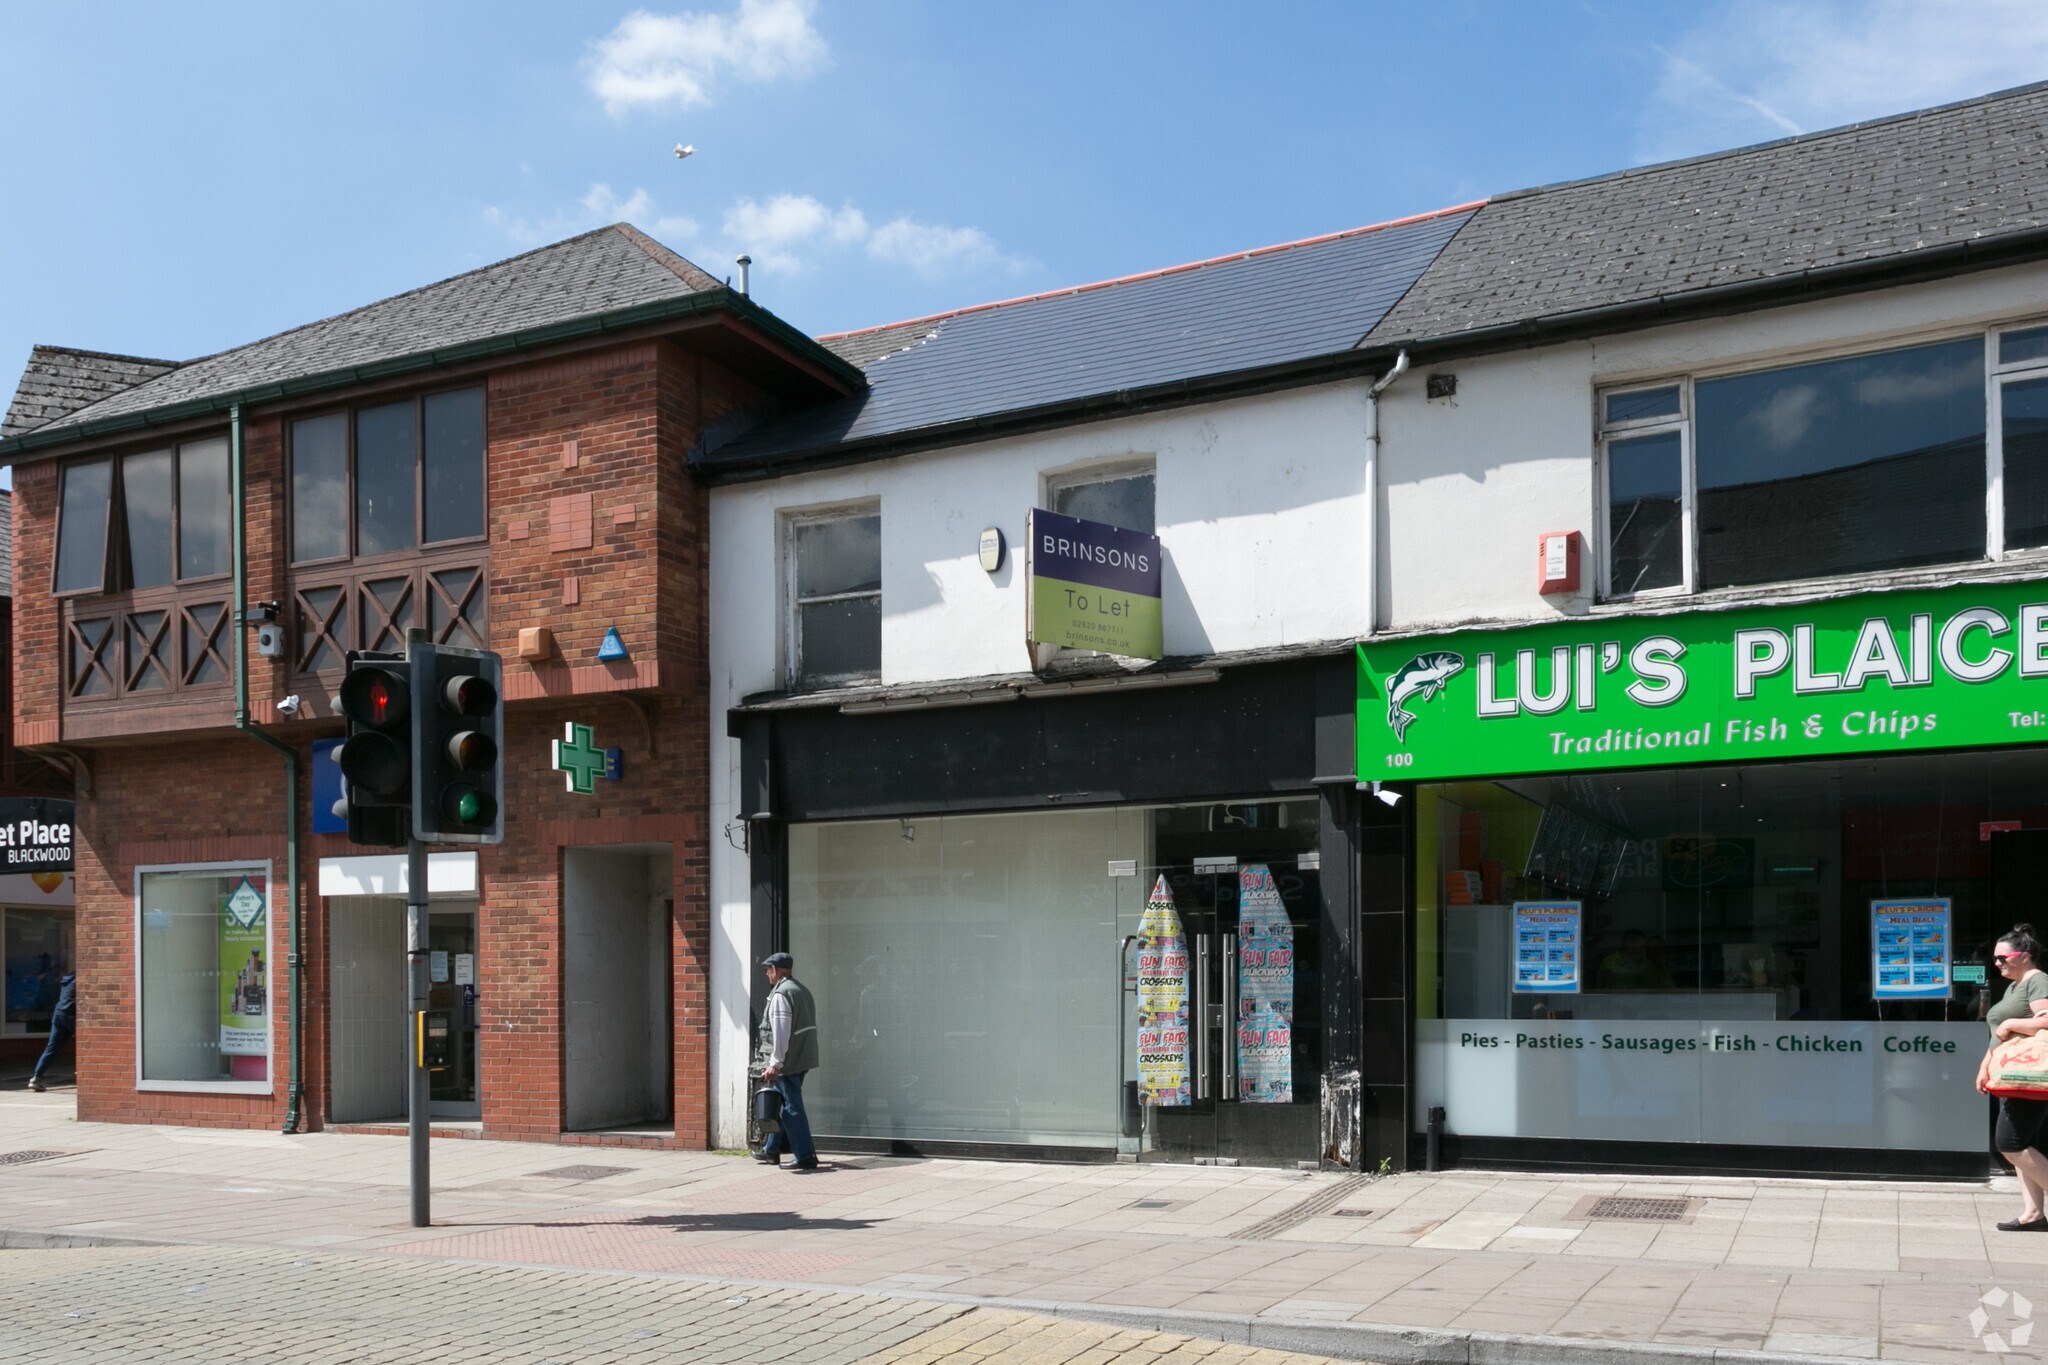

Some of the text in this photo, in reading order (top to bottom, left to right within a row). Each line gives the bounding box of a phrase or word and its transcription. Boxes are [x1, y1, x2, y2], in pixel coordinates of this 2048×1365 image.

[1043, 535, 1149, 573] BRINSONS
[1064, 588, 1130, 618] To Let
[1066, 629, 1130, 648] brinsons.co.uk
[1476, 635, 1689, 719] LUI'S
[2007, 711, 2047, 728] Tel:
[1549, 709, 1938, 755] Traditional Fish & Chips
[1385, 752, 1414, 768] 100
[20, 819, 71, 846] Place
[8, 846, 71, 863] BLACKWOOD
[1242, 872, 1264, 890] FUN
[1139, 955, 1187, 969] FUN FAIR
[1242, 948, 1292, 967] FUN FAIR
[1139, 977, 1184, 986] CROSSKEYS
[1244, 968, 1290, 977] BLACKWOOD
[1138, 1031, 1187, 1047] FUN FAIR
[1240, 1028, 1290, 1047] FUN FAIR
[1461, 1033, 1499, 1048] Pies
[1516, 1033, 1584, 1049] Pasties
[1601, 1034, 1697, 1054] Sausages
[1714, 1035, 1756, 1051] Fish
[1775, 1035, 1863, 1052] Chicken
[1883, 1036, 1956, 1053] Coffee
[1139, 1054, 1184, 1063] CROSSKEYS
